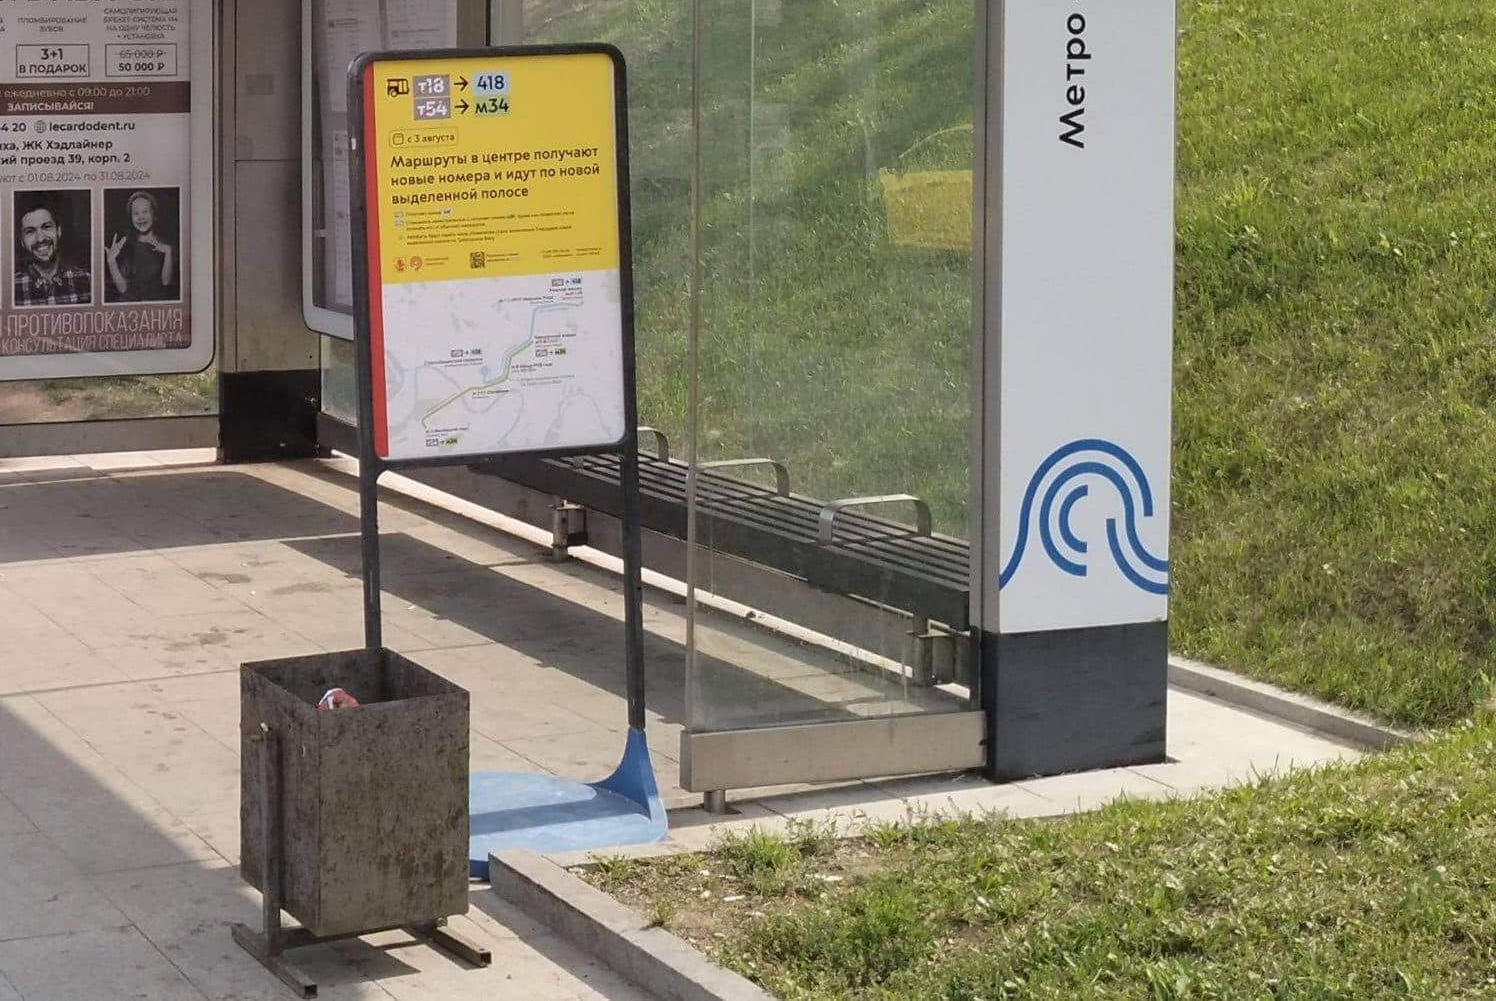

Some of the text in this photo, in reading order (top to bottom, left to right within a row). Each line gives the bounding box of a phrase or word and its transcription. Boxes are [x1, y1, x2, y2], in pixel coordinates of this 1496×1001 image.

[40, 48, 64, 60] 3+1
[19, 63, 87, 75] В ПОДАРОК
[118, 62, 132, 72] 50
[134, 62, 154, 72] 000
[477, 75, 505, 90] 418
[1058, 12, 1092, 149] Метро
[4, 89, 67, 100] ежедневно
[109, 88, 123, 98] до
[125, 86, 151, 97] 21:00
[7, 100, 94, 112] ЗАПИСЫВАЙСЯ!
[12, 122, 27, 132] 20
[49, 120, 136, 132] lecardodent.ru
[415, 134, 420, 143] 3
[422, 133, 455, 143] августа
[22, 140, 42, 151] ЖК
[46, 139, 113, 151] Хэдлайнер
[20, 155, 66, 167] проезд
[67, 154, 85, 165] 39,
[88, 154, 121, 165] корп.
[123, 153, 131, 163] 2
[390, 147, 598, 169] Маршруты в центре получают
[84, 173, 96, 181] по
[391, 163, 600, 186] новые номера и идут по новой
[392, 187, 529, 205] выделенной полосе
[7, 308, 183, 337] ПРОТИВОПОКАЗАНИЯ
